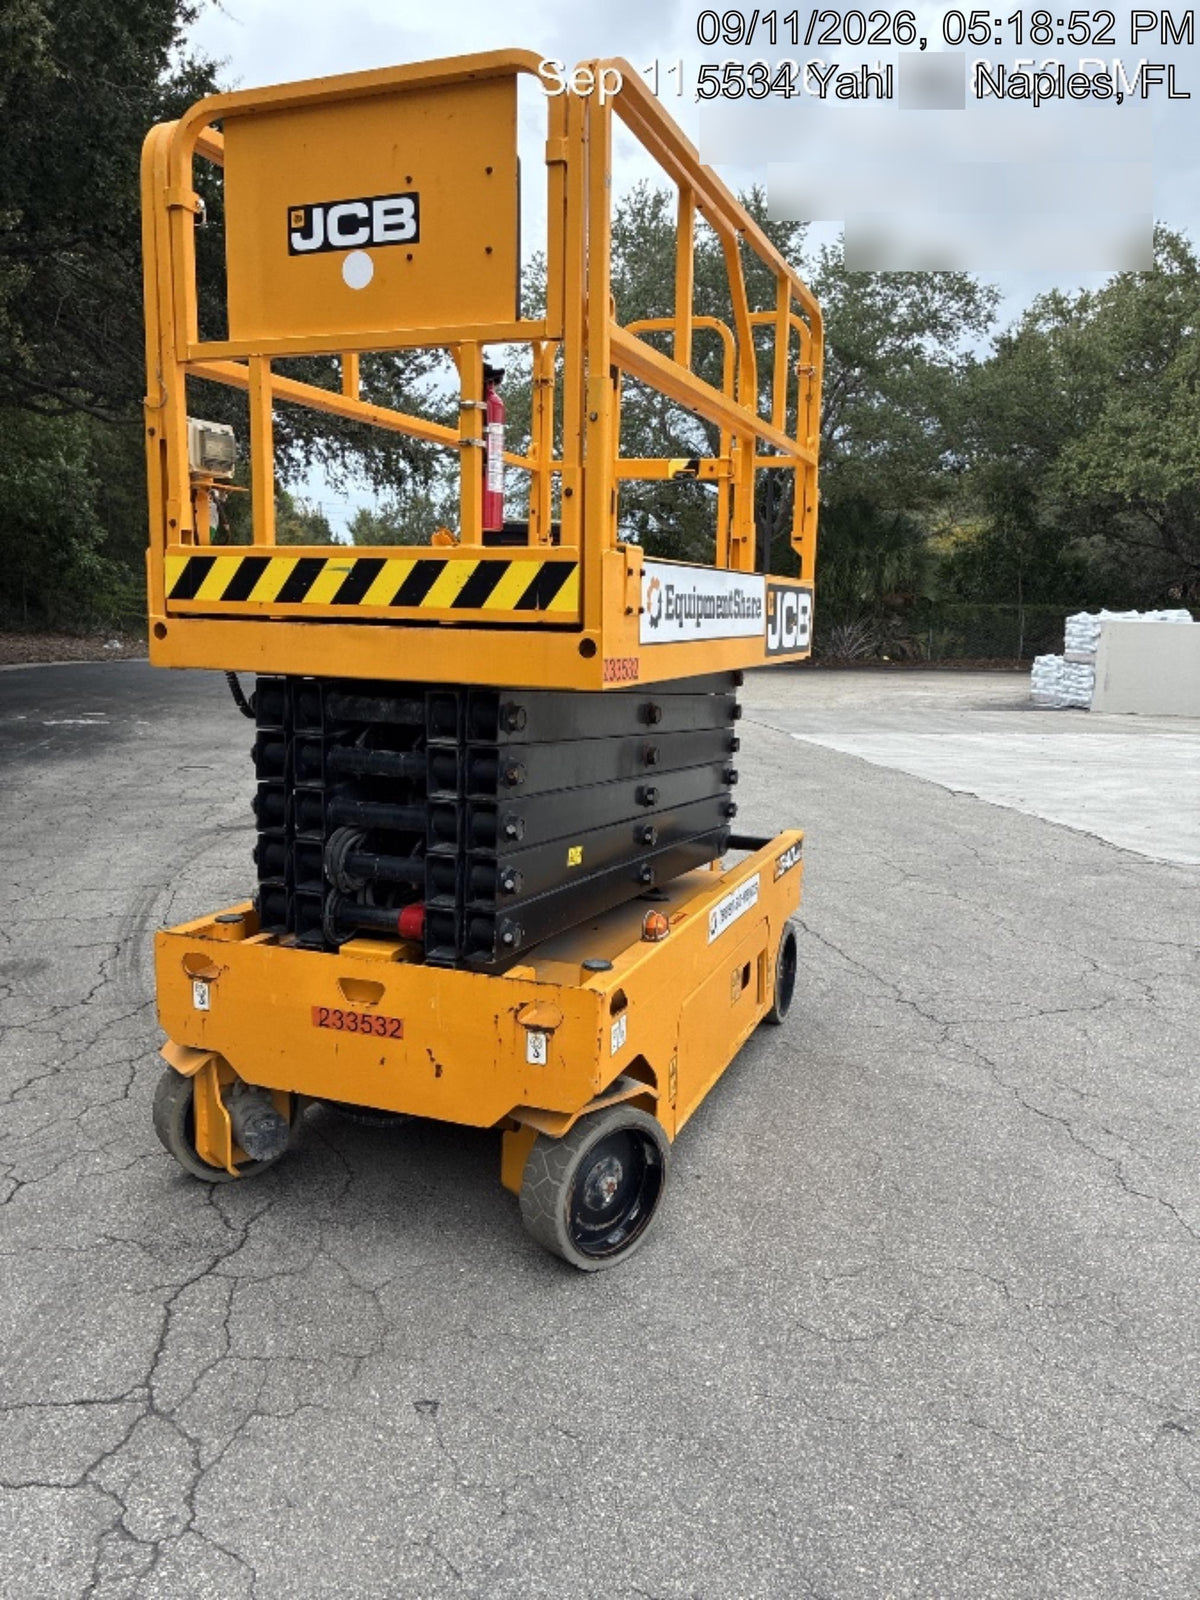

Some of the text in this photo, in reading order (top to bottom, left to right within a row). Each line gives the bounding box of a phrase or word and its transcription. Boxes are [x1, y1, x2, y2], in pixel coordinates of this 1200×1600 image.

[290, 197, 417, 251] JCB
[664, 585, 762, 628] EquipmentShare
[767, 591, 812, 650] JCB
[318, 1007, 403, 1039] 233532
